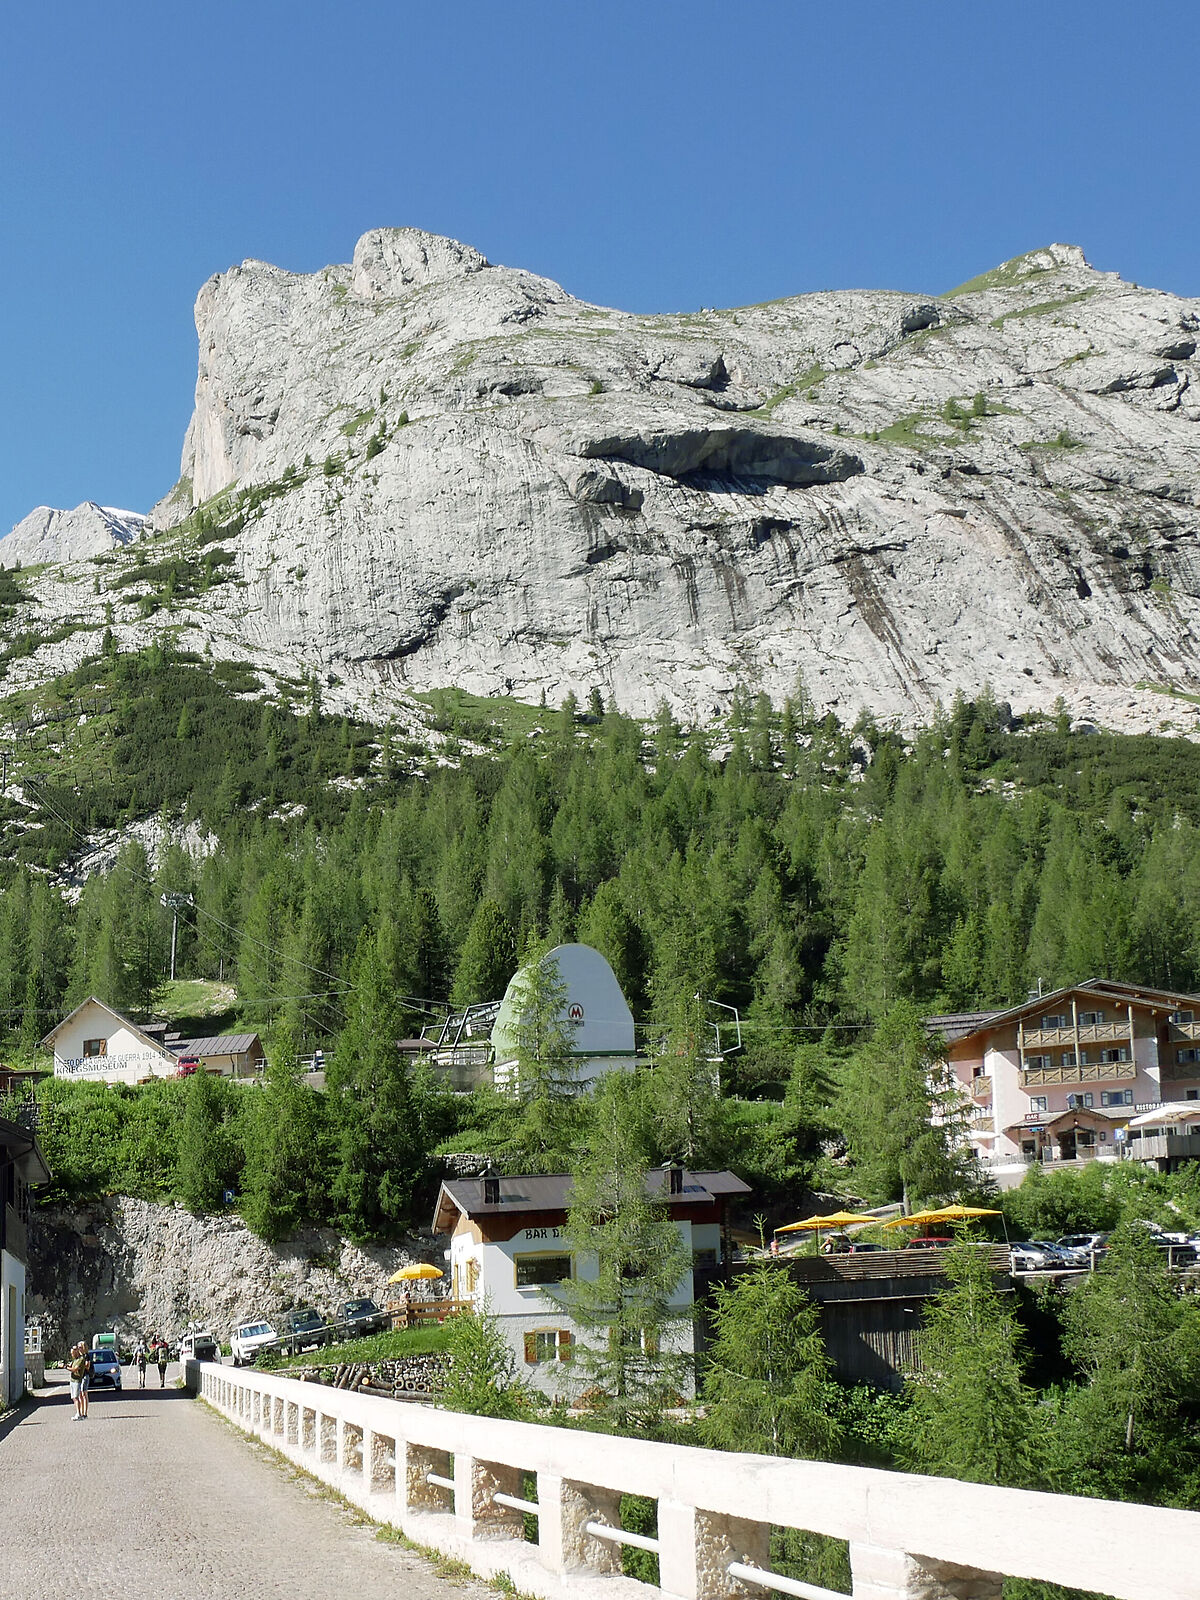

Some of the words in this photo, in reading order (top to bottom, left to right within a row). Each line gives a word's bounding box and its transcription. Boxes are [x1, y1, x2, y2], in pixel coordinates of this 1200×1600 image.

[117, 1053, 141, 1062] GUERRA
[56, 1061, 128, 1074] KRIEGSMUSEUM
[525, 1229, 548, 1239] BAR
